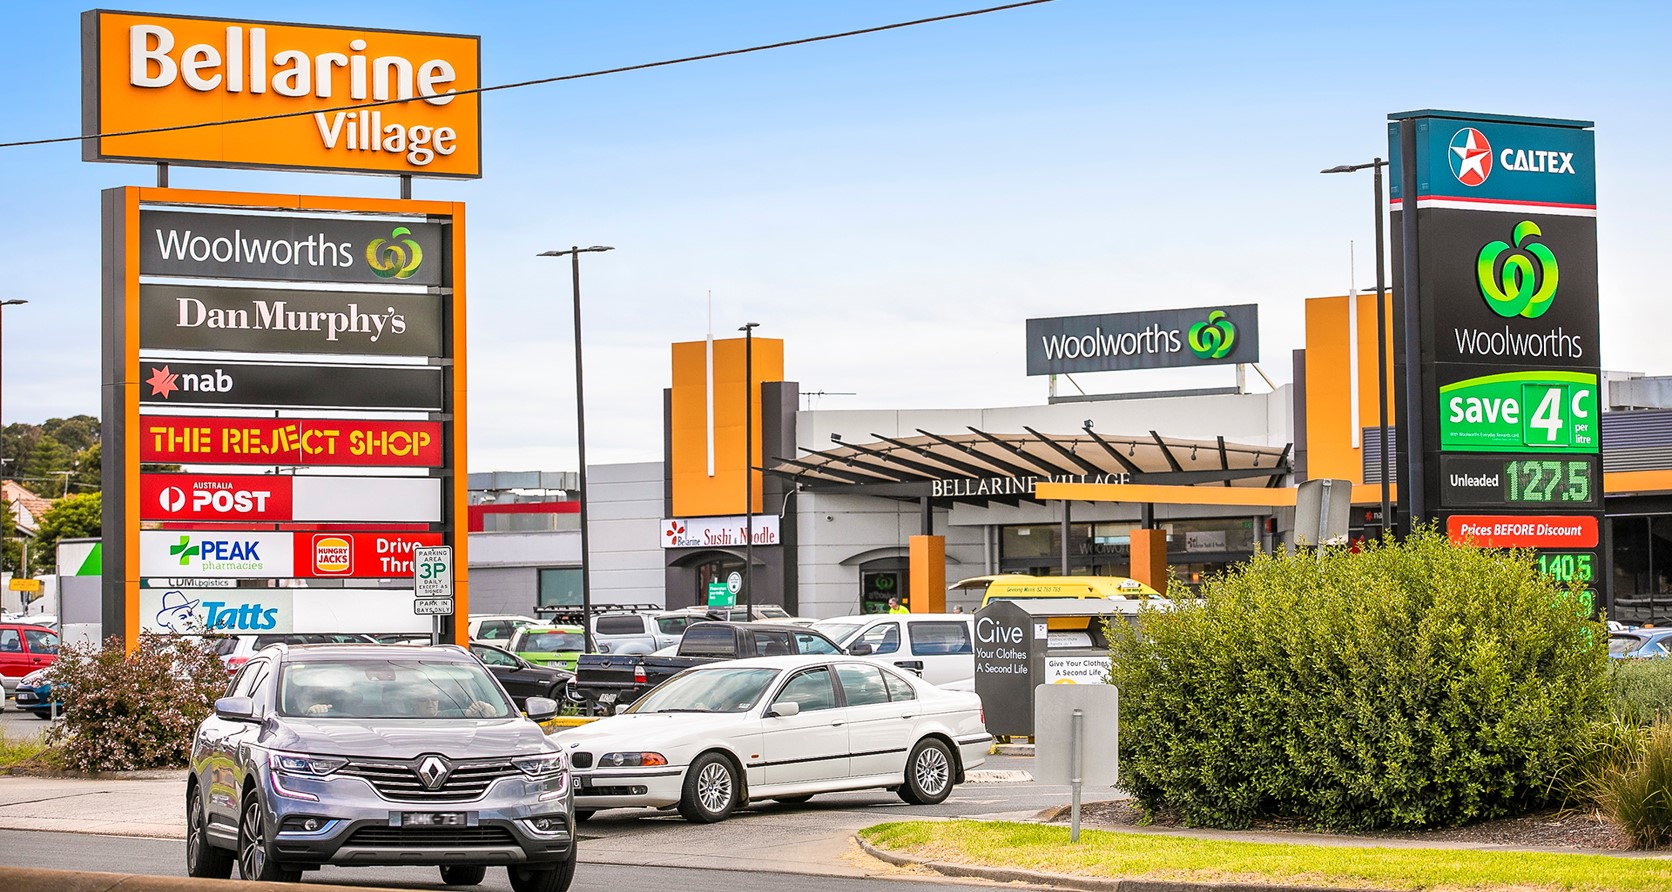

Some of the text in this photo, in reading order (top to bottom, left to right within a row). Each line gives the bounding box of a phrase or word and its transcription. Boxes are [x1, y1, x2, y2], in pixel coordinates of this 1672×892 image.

[129, 24, 457, 106] Bellarine
[314, 108, 457, 167] Village
[1500, 148, 1575, 175] CALTEX
[156, 229, 353, 268] Woolworths
[176, 297, 406, 342] Dan Murphy's
[1042, 323, 1182, 361] Woolworths
[1455, 326, 1583, 359] Woolworths
[182, 369, 234, 394] nab
[1449, 396, 1520, 425] save
[1530, 388, 1564, 441] 4
[1575, 423, 1589, 434] per
[1575, 434, 1591, 445] litre
[149, 424, 431, 456] THE REJECT SHOP
[193, 482, 233, 490] AUSTRALIA
[932, 475, 1038, 497] BELLARINE
[1450, 461, 1589, 502] Unleaded 127.5
[192, 490, 271, 513] POST
[703, 528, 732, 546] Sushi
[739, 526, 775, 545] Nodle
[1460, 523, 1582, 536] Prices BEFORE Discount
[201, 540, 260, 561] PEAK
[318, 547, 348, 555] HUNGRY
[376, 537, 422, 554] Drive
[202, 561, 264, 572] pharmacies
[419, 562, 447, 579] 3P
[201, 601, 278, 631] Tatts
[976, 616, 1024, 644] Give
[976, 647, 1027, 660] Your Clothes
[1082, 659, 1109, 668] Clothes
[976, 662, 1028, 674] A Second Life
